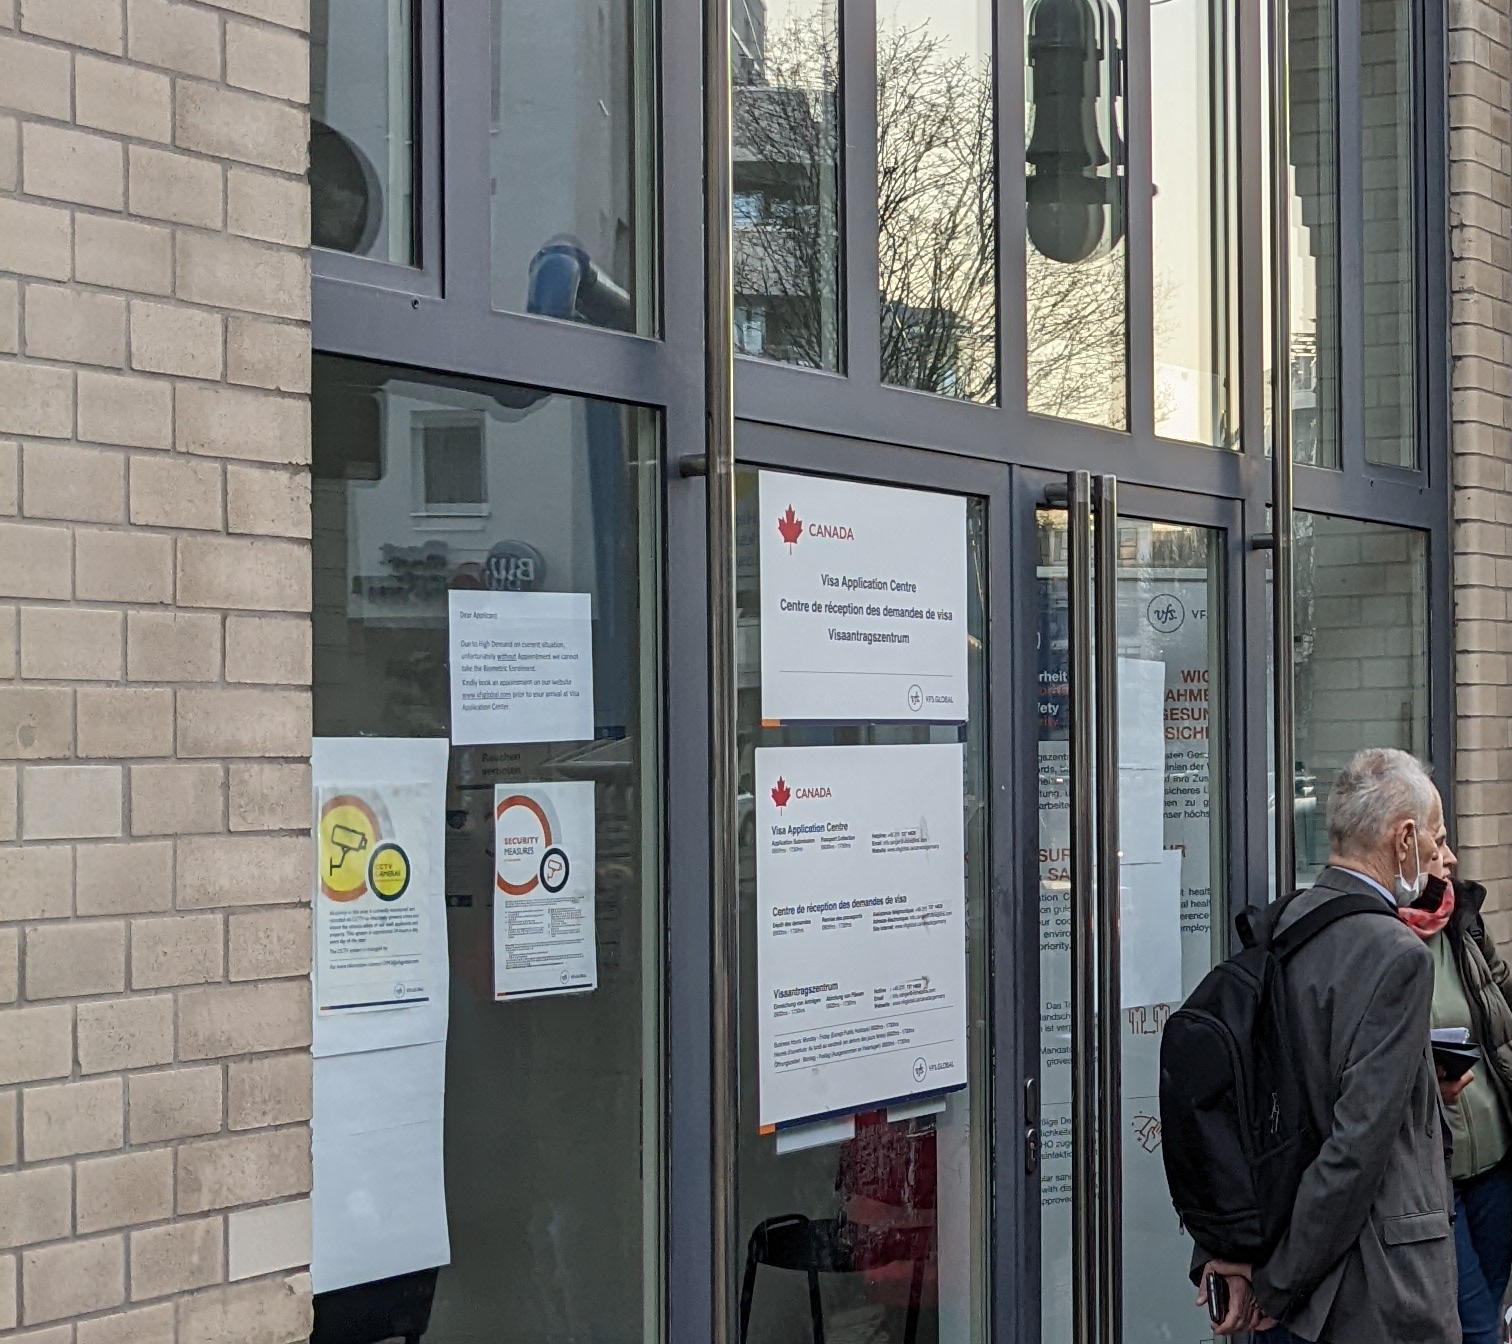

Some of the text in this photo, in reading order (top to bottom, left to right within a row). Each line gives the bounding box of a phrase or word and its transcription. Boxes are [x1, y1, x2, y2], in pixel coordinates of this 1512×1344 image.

[809, 523, 855, 541] CANADA
[821, 574, 917, 593] Visa Application Centre
[780, 598, 953, 621] Centre de réception des demandes de visa
[828, 628, 910, 646] Visaantragszentrum
[796, 788, 832, 799] CANADA
[771, 822, 849, 836] Visa Application Centre
[504, 837, 539, 845] SECURITY
[504, 847, 534, 855] MEASURES
[773, 893, 908, 917] Centre de réception des demandes de visa
[773, 983, 839, 999] Visaantragszentrum
